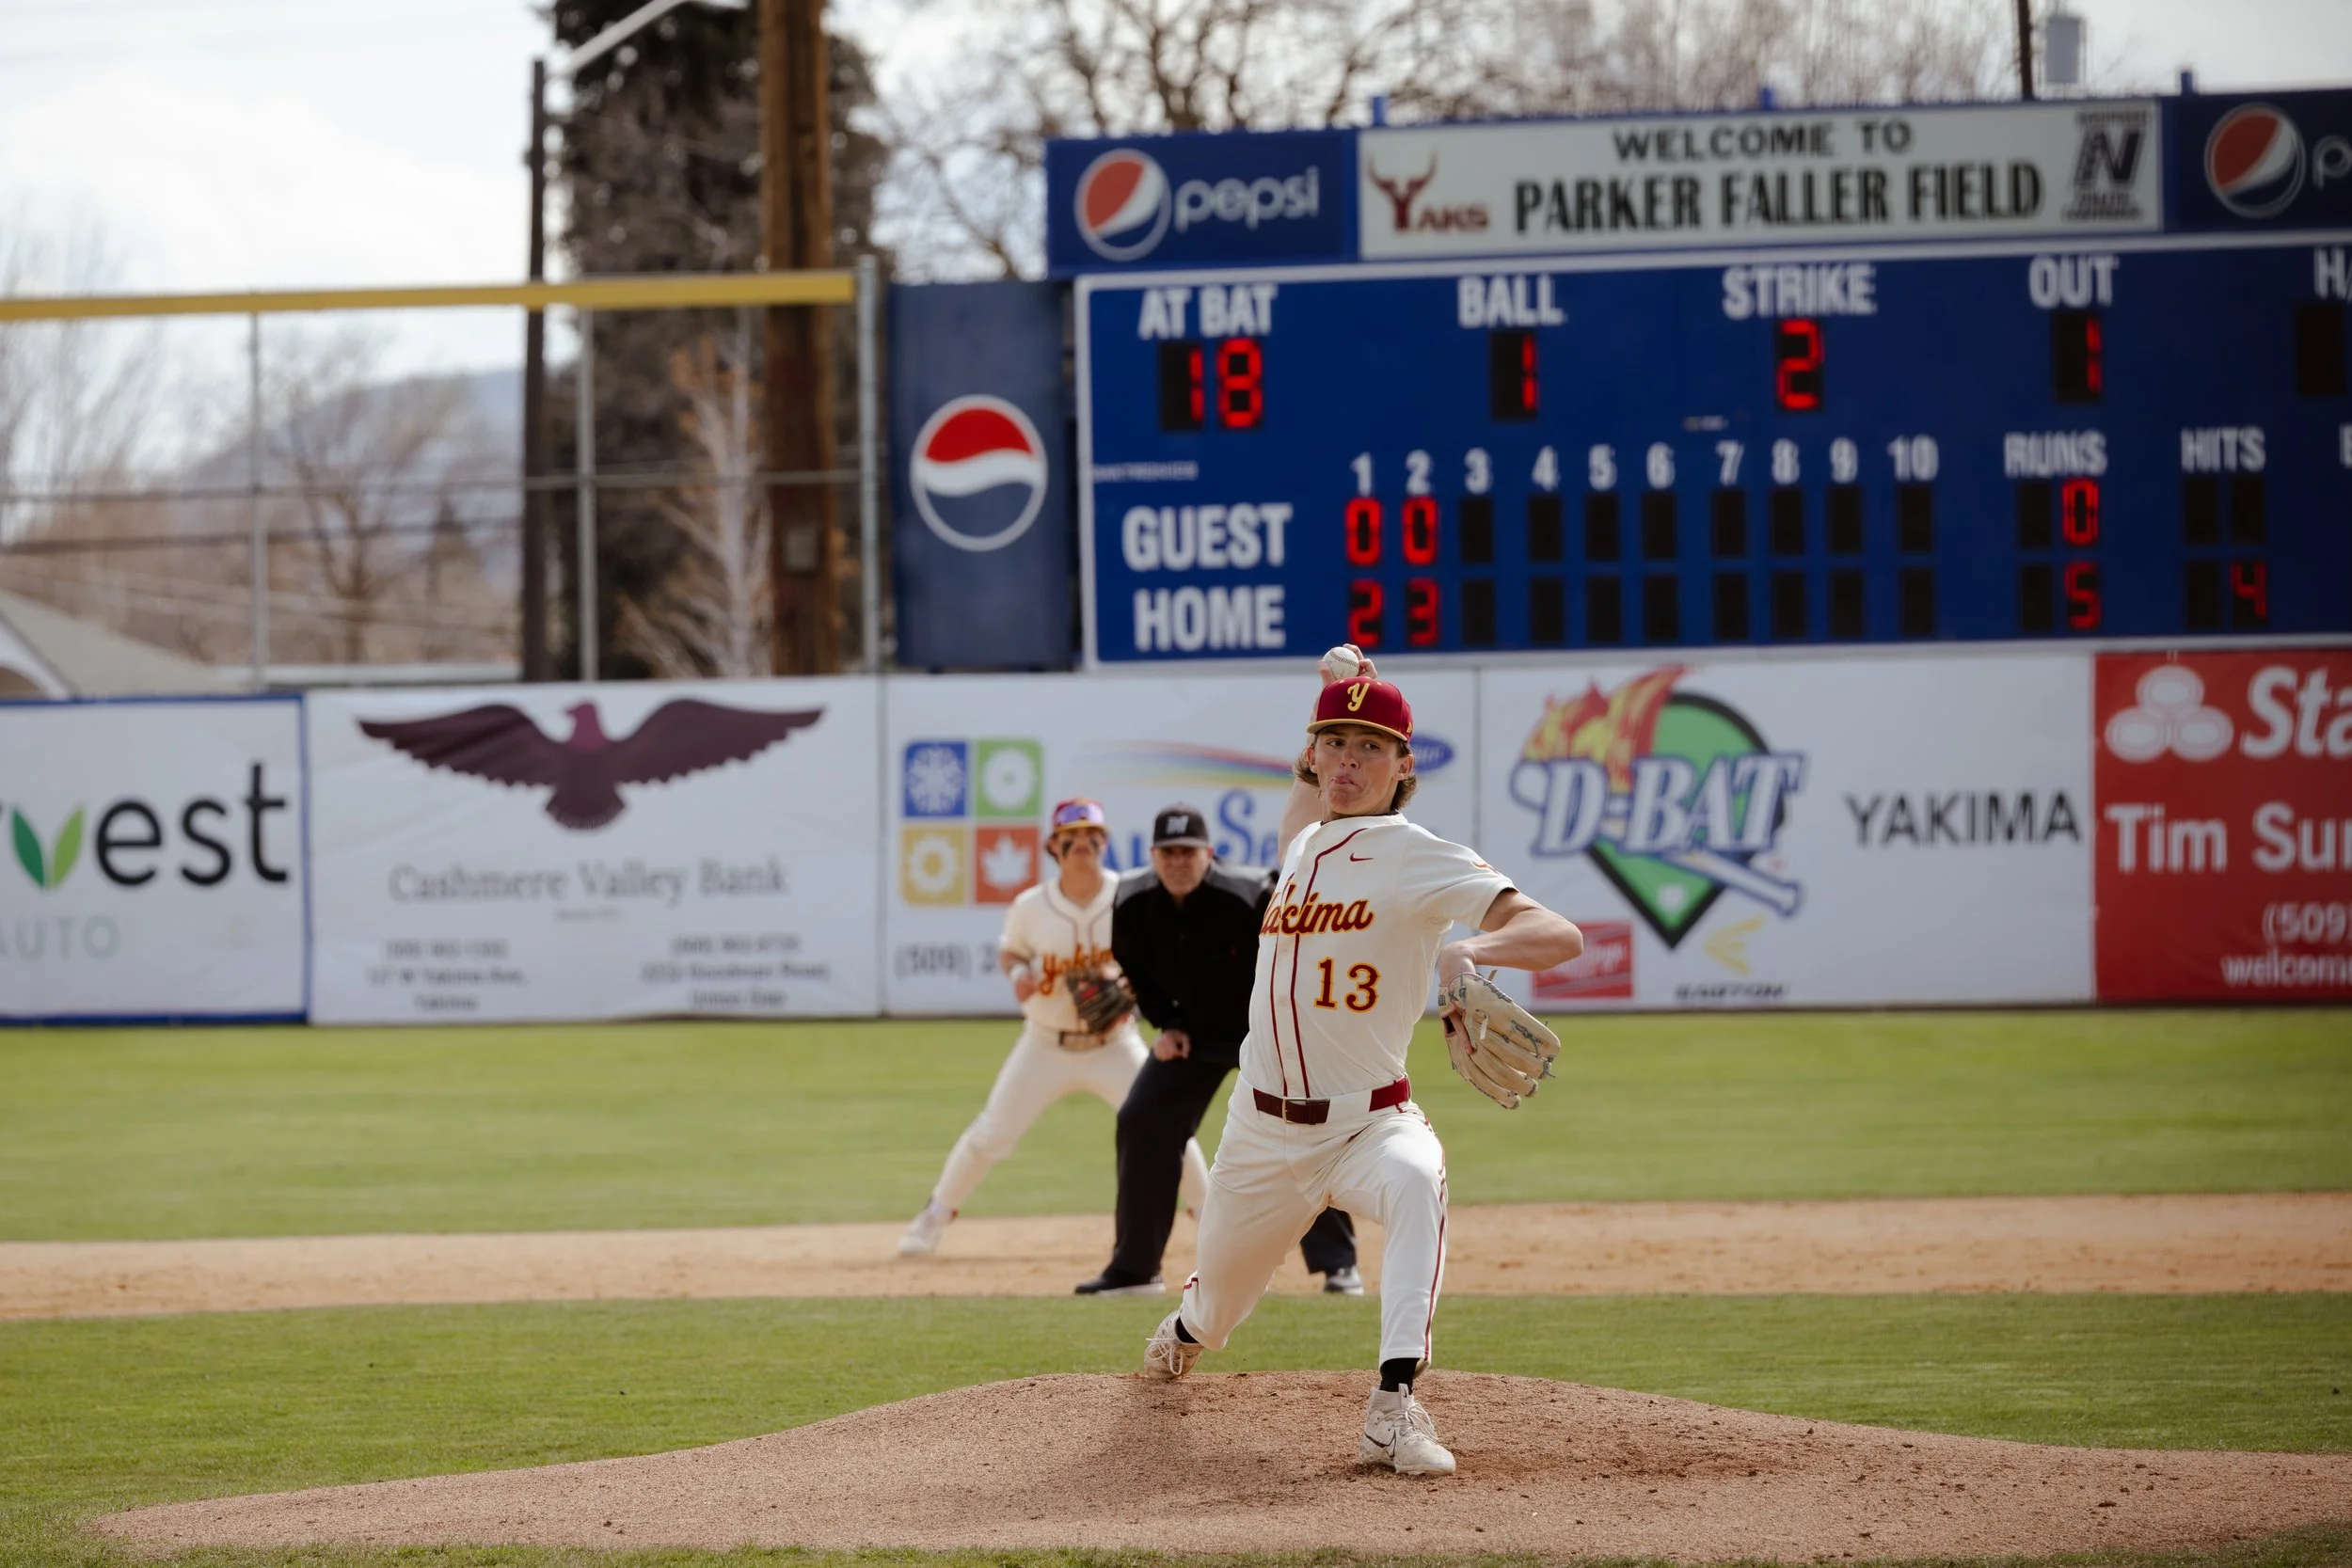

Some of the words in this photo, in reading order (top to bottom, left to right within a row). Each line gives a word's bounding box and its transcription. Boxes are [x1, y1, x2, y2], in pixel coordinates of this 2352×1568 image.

[1614, 121, 1835, 162] WELCOME
[1856, 119, 1912, 150] TO
[1173, 166, 1320, 232] pepsi
[1514, 175, 1708, 235] PARKER
[1720, 165, 1889, 228] FALLER
[1906, 158, 2044, 221] FIELD
[1457, 277, 1565, 327] BALL
[1723, 264, 1877, 318] STRIKE
[2027, 254, 2118, 308] OUT
[1138, 289, 1194, 340] AT
[1200, 286, 1276, 337] BAT
[1188, 337, 1263, 429] 18
[1776, 318, 1823, 408] 2
[1350, 453, 1373, 495] 1
[1406, 451, 1432, 495] 2
[1464, 449, 1491, 494] 3
[1532, 447, 1560, 489] 4
[1588, 445, 1616, 489] 5
[1646, 442, 1676, 488] 6
[1716, 441, 1744, 483] 7
[1772, 439, 1799, 483] 8
[1830, 438, 1858, 483] 9
[1887, 436, 1938, 481] 10
[2004, 432, 2107, 476] RUNS
[2181, 427, 2265, 472] HITS
[1121, 503, 1293, 572] GUEST
[1346, 497, 1382, 565] 0
[1403, 495, 1438, 564] 0
[2062, 478, 2099, 546] 0
[1134, 586, 1285, 651] HOME
[1349, 579, 1383, 647] 2
[1406, 578, 1439, 646] 3
[2065, 563, 2100, 629] 5
[2231, 561, 2266, 620] 4
[0, 761, 288, 892] vest
[1845, 788, 2081, 847] YAKIMA
[2106, 804, 2228, 874] Tim
[388, 862, 568, 902] Cashmere
[577, 858, 688, 908] Valley
[699, 857, 788, 895] Bank
[1259, 883, 1375, 937] akima
[0, 914, 120, 960] UTO
[1313, 957, 1381, 1013] 13
